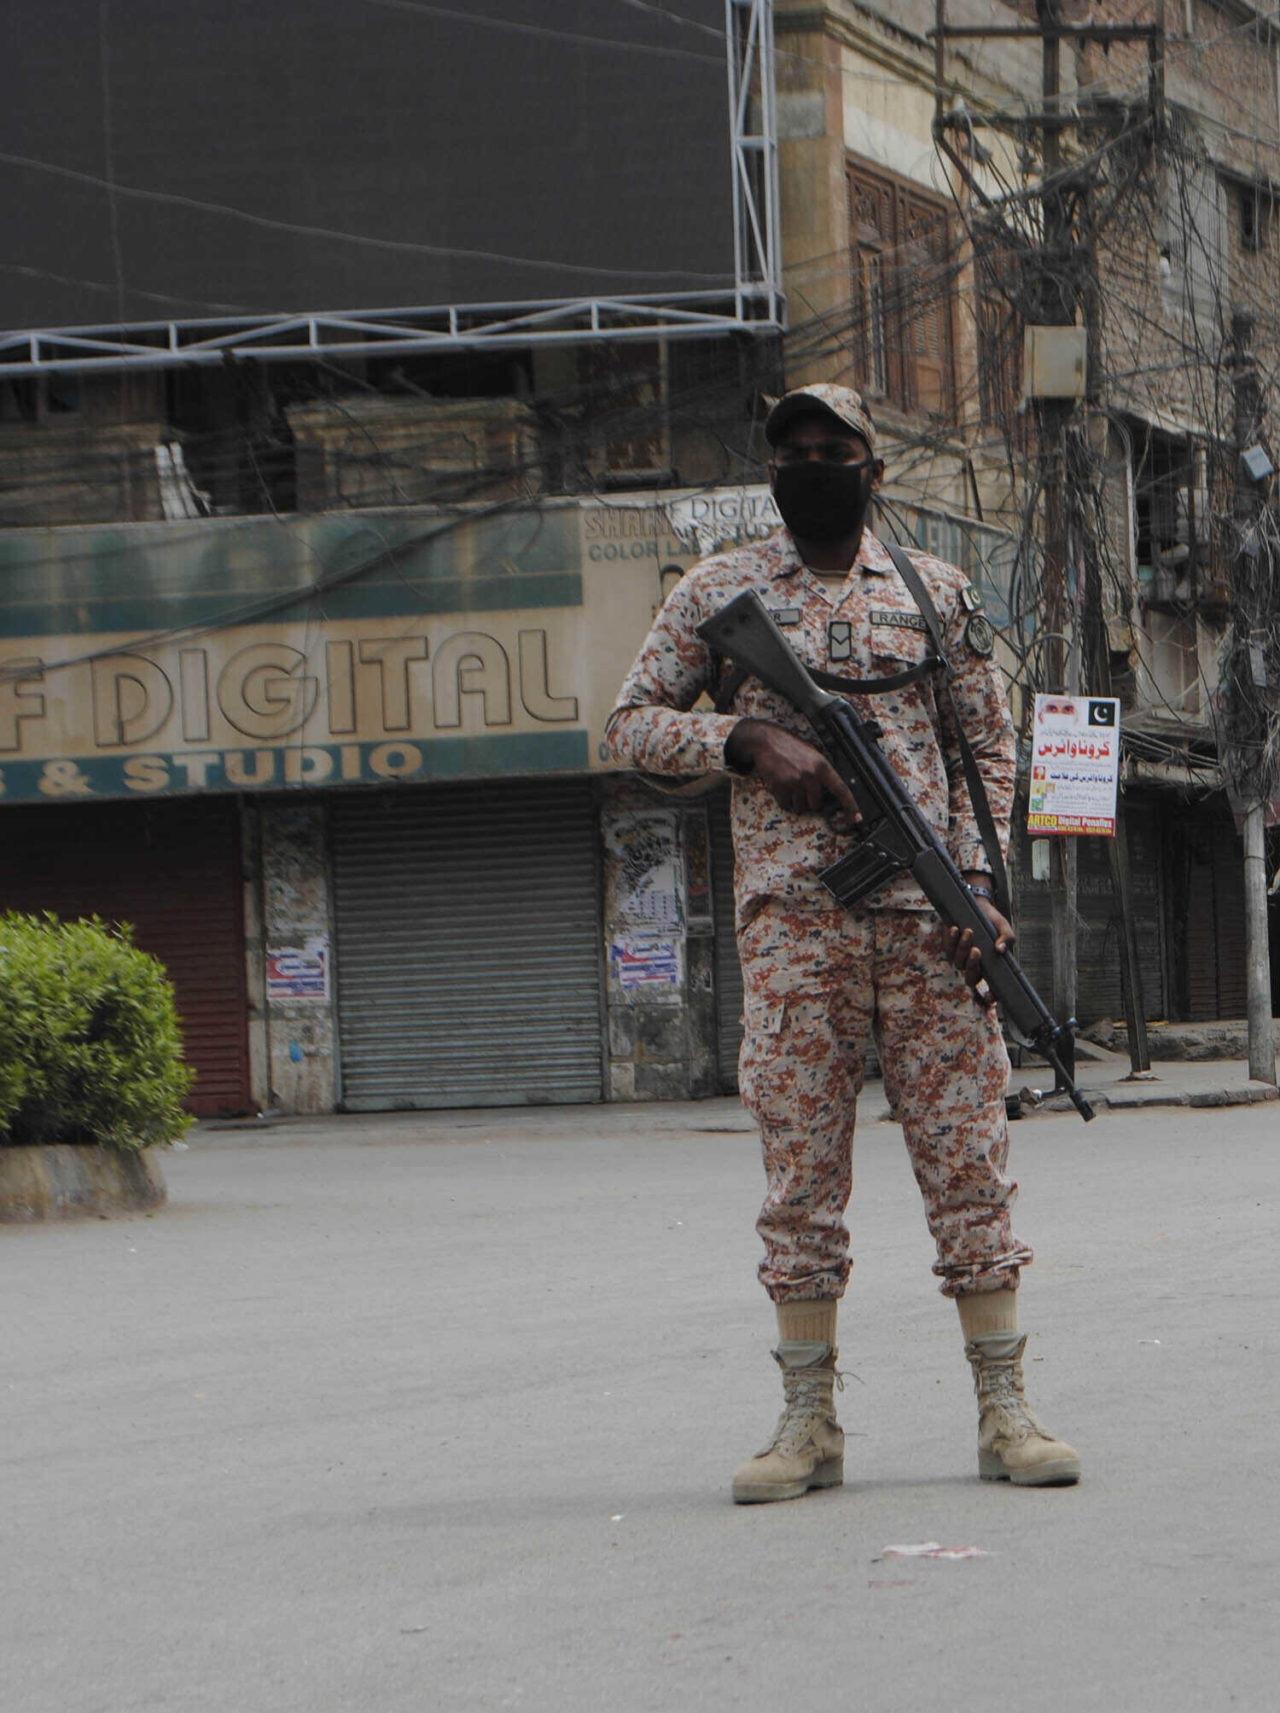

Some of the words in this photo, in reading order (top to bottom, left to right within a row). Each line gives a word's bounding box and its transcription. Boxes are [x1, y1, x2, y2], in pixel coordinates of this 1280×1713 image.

[691, 494, 778, 520] DIGITA
[588, 540, 657, 562] COLOR
[89, 629, 580, 746] DIGITAL
[38, 759, 95, 796] &
[123, 742, 424, 791] STUDIO
